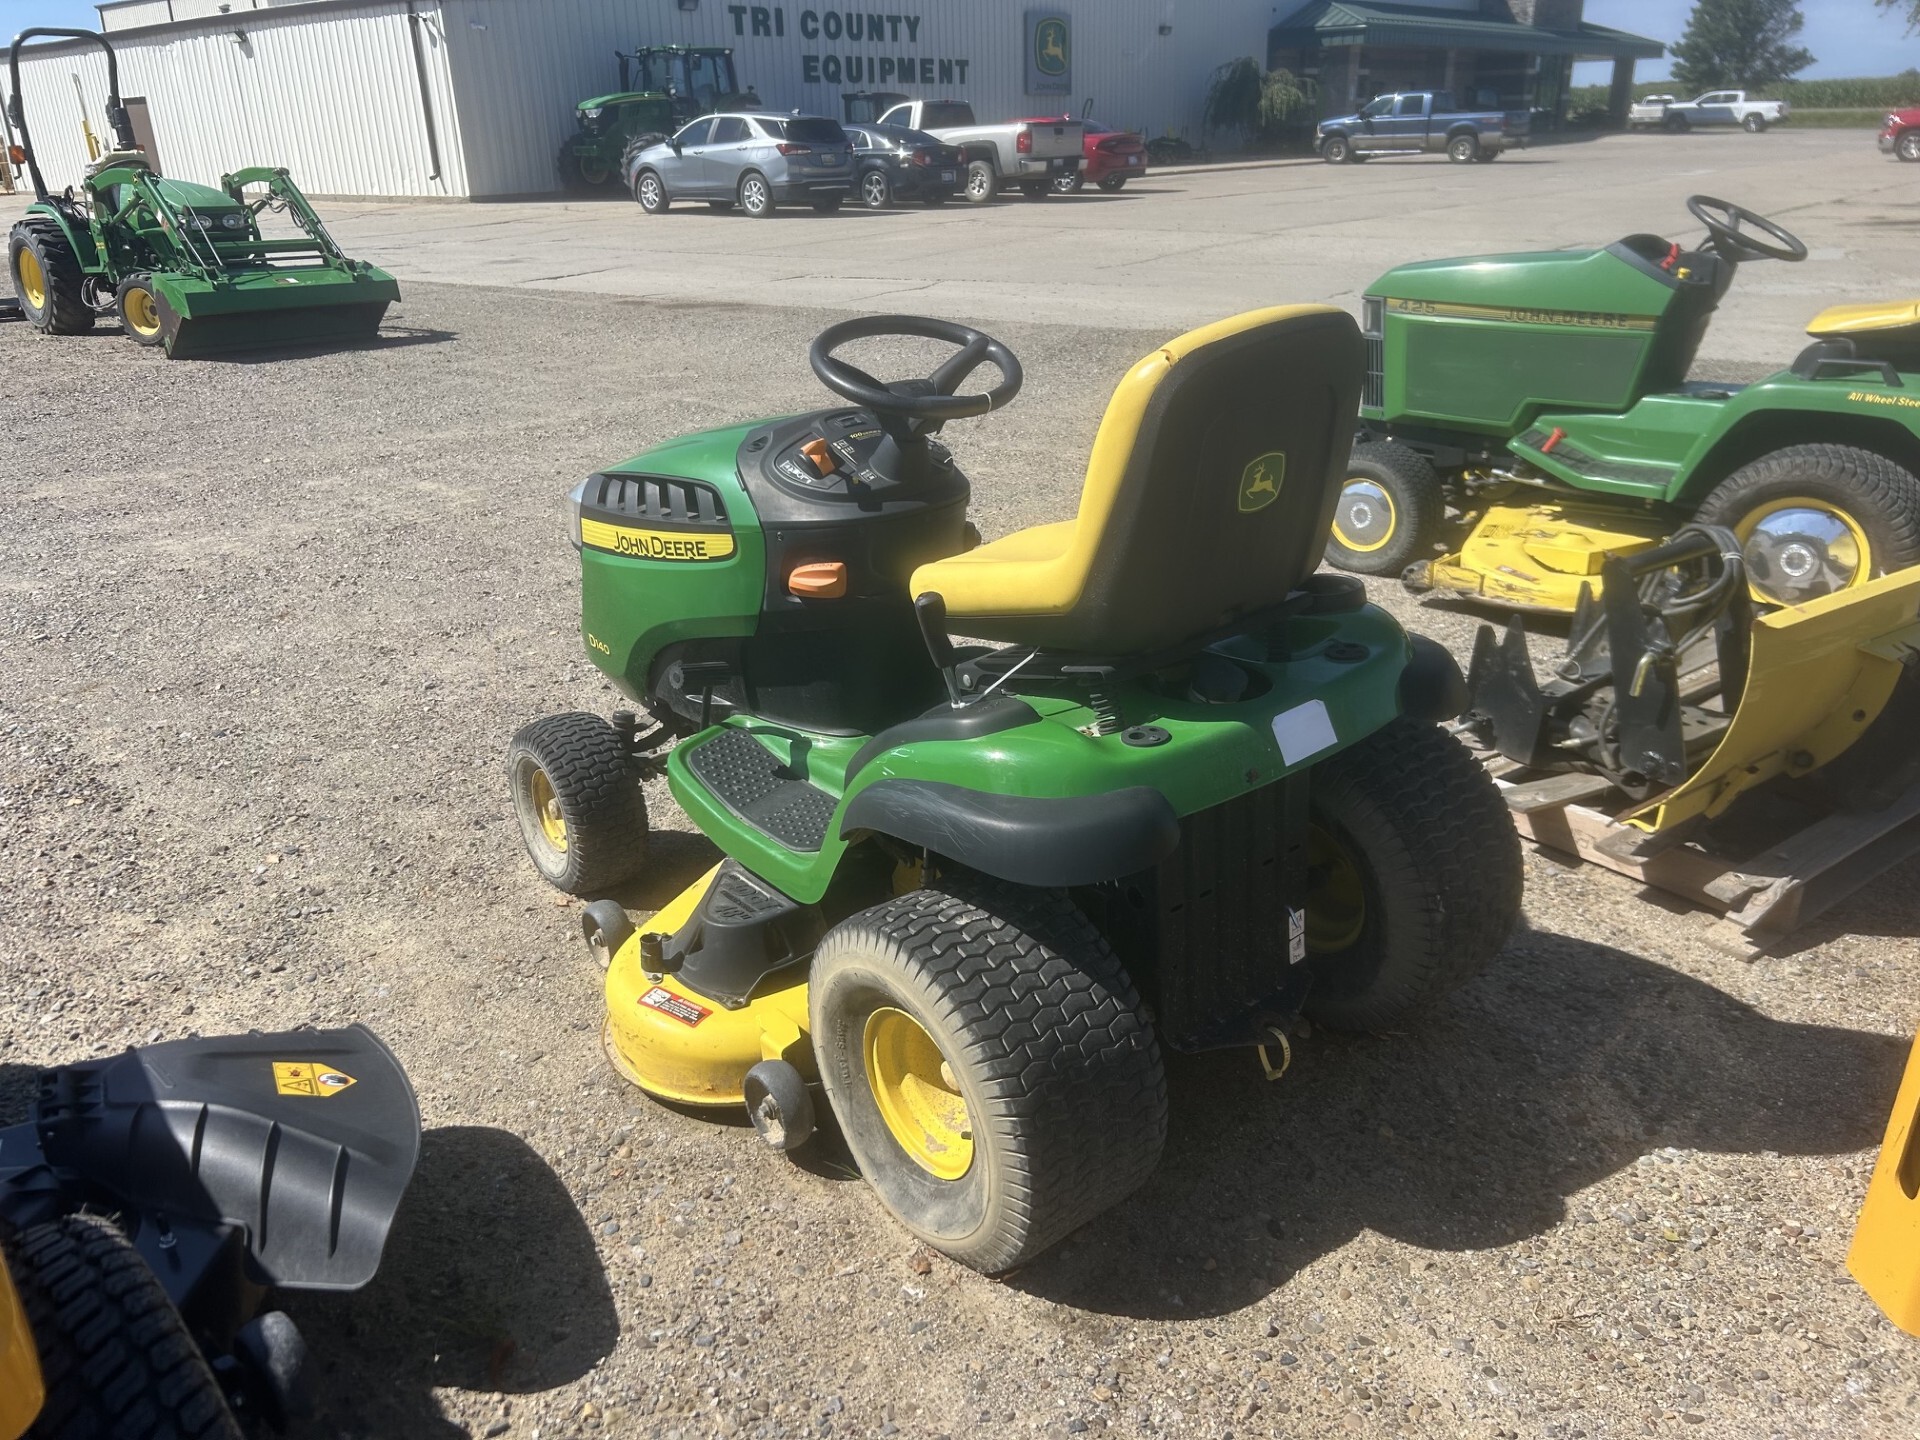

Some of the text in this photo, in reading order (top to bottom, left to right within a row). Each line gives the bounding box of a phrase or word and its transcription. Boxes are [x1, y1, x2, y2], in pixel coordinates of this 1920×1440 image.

[728, 5, 921, 42] TRI COUNTY
[802, 54, 969, 84] EQUIPMENT
[1400, 300, 1436, 314] 425
[1504, 309, 1628, 328] JOHN DEERE
[1848, 392, 1864, 401] All
[1865, 393, 1898, 405] Wheel
[614, 531, 708, 557] JOHN DEERE
[588, 632, 610, 655] D140
